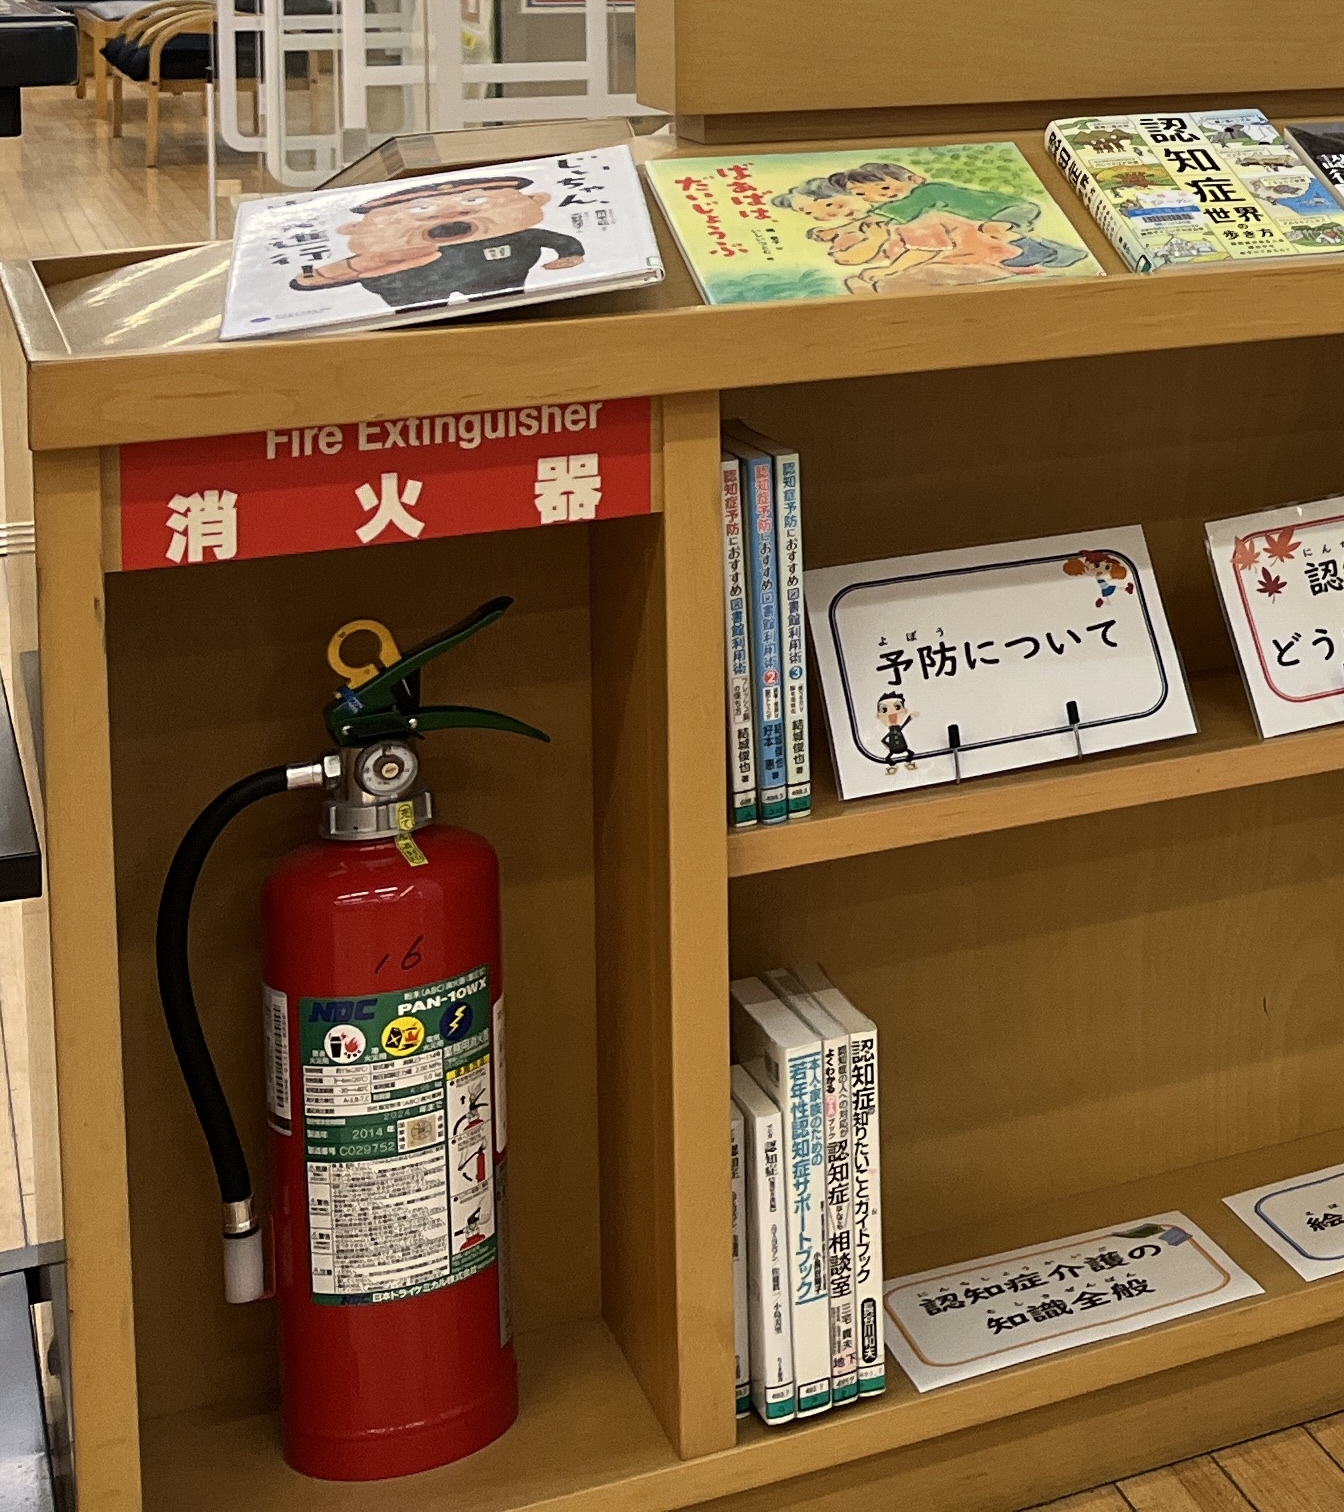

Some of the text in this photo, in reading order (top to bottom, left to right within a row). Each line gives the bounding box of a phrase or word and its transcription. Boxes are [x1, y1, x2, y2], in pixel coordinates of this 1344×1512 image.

[675, 176, 748, 257] だいじょうぶ
[1140, 117, 1274, 240] 認知症 世界 歩き方
[266, 401, 602, 460] Fire Extinguisher
[165, 453, 602, 563] 消火器
[723, 469, 748, 675] 認知症予防におすすめ図書館利用術
[782, 462, 801, 664] 認知症予防におすすめ図書館利用術
[876, 620, 1118, 686] 予防について
[309, 999, 378, 1022] NDC
[397, 979, 487, 1016] PAN-10WX
[353, 1128, 383, 1139] 2014
[808, 1058, 823, 1166] 本人・家族のための
[789, 1062, 813, 1300] 若年性認知症サポートブック
[828, 1139, 852, 1299] 認知症 相談室
[918, 1240, 1163, 1318] 認知症介護の
[986, 1276, 1157, 1335] 知識全般
